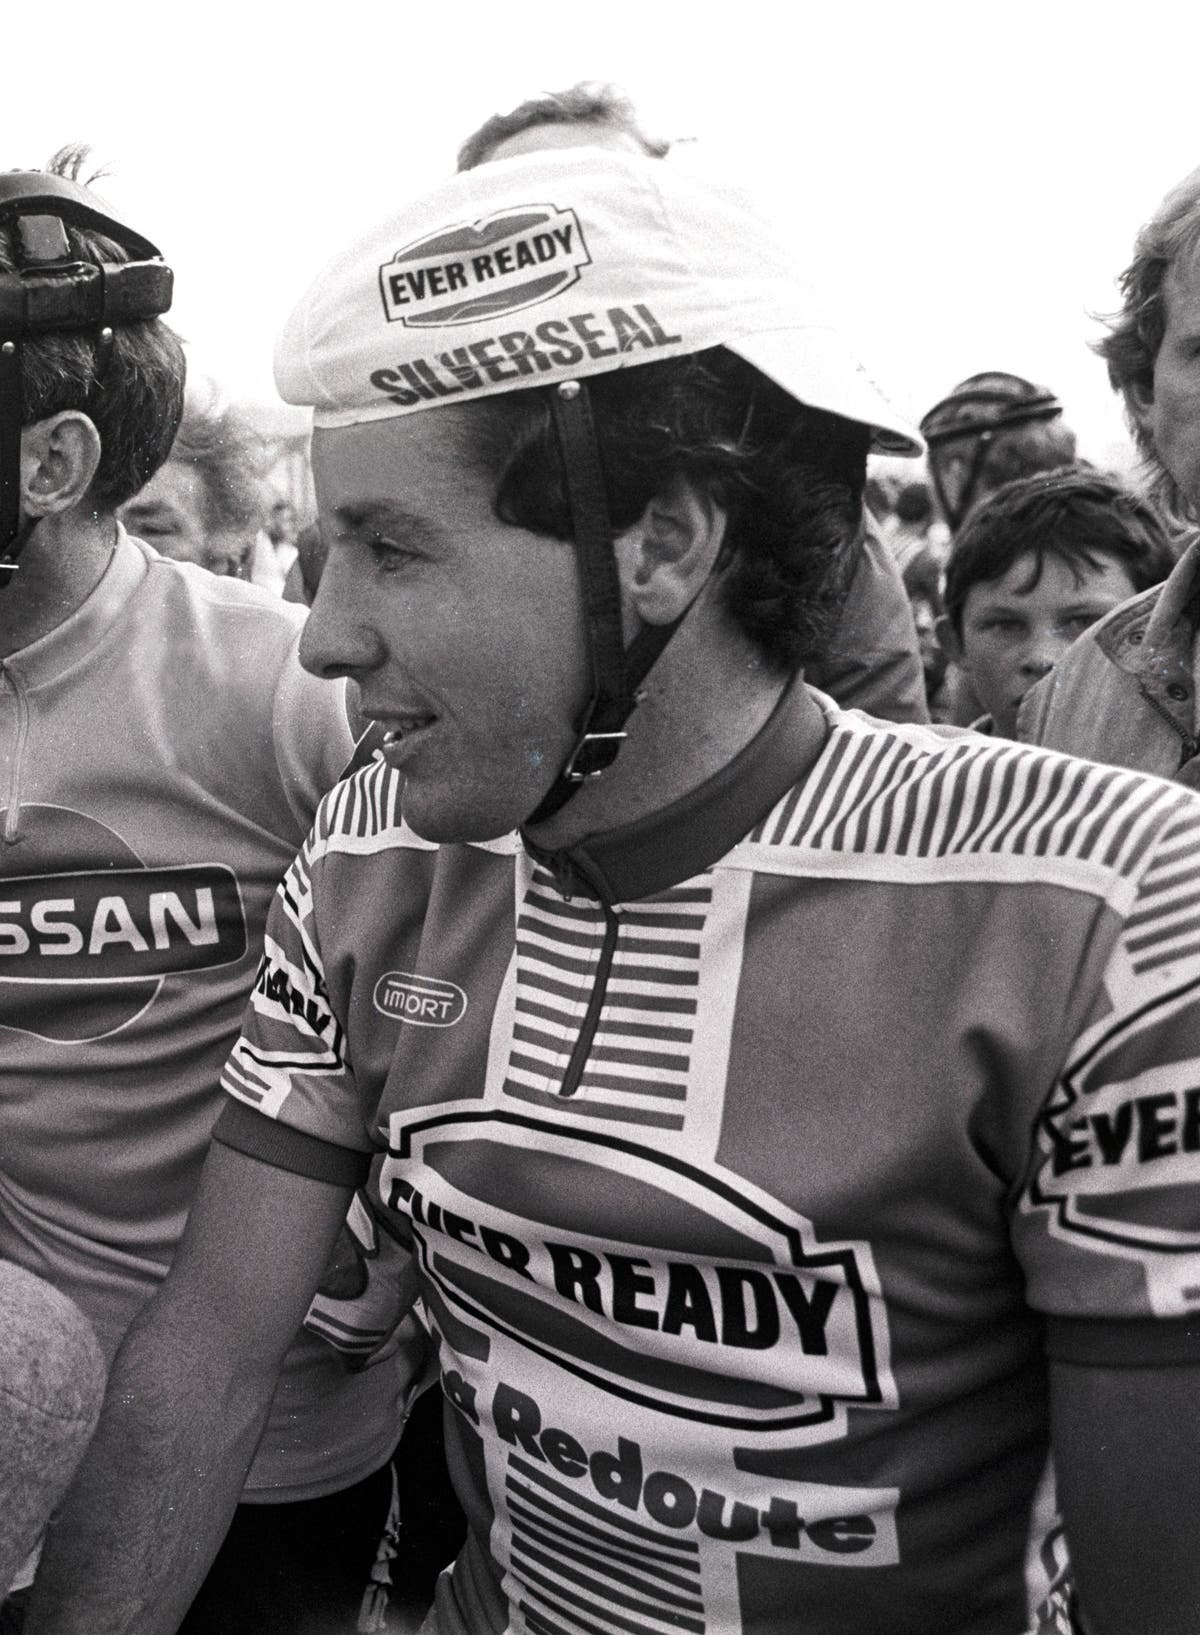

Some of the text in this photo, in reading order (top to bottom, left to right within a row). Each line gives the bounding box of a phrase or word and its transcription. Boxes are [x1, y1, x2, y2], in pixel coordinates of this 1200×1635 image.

[389, 225, 572, 305] EVER READY
[369, 303, 682, 407] SILVERSEAL
[543, 1240, 840, 1357] READY
[491, 1382, 877, 1554] Redoute
